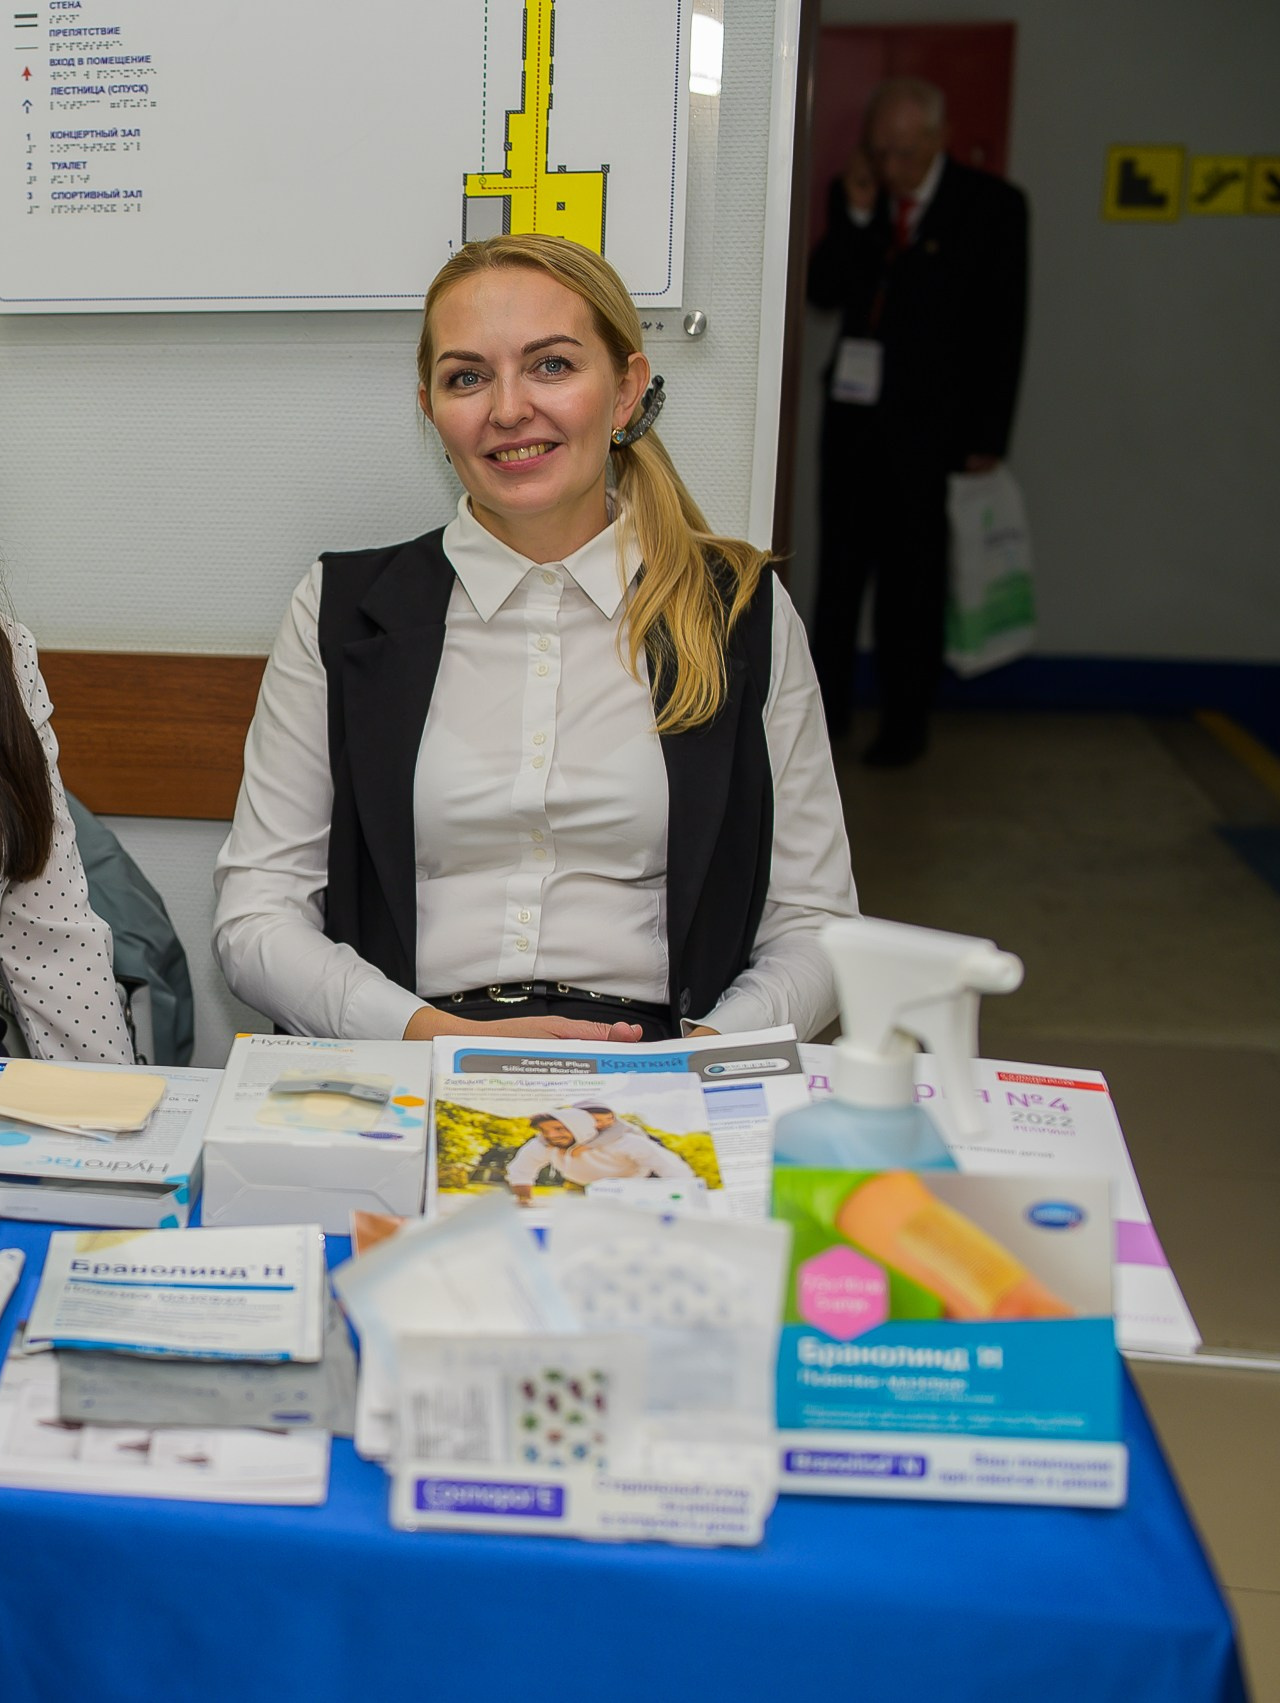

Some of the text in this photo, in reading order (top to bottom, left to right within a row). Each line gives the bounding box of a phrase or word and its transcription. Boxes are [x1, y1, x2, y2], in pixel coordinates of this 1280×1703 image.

[49, 1, 82, 9] СТЕНА
[49, 27, 121, 37] ПРЕПЯТСТВИЕ
[49, 55, 151, 67] ВХОД В ПОМЕЩЕНИЕ
[50, 84, 149, 96] ЛЕСТНИЦА (СПУСК)
[26, 127, 141, 141] 1 КОНЦЕРТНЫЙ ЗАЛ
[26, 161, 87, 170] 2 ТУАЛЕТ
[26, 188, 142, 200] 3 СПОРТИВНЫЙ ЗАЛ
[565, 1059, 590, 1069] Plus
[600, 1056, 684, 1071] Краткий
[1010, 1110, 1074, 1129] 2022
